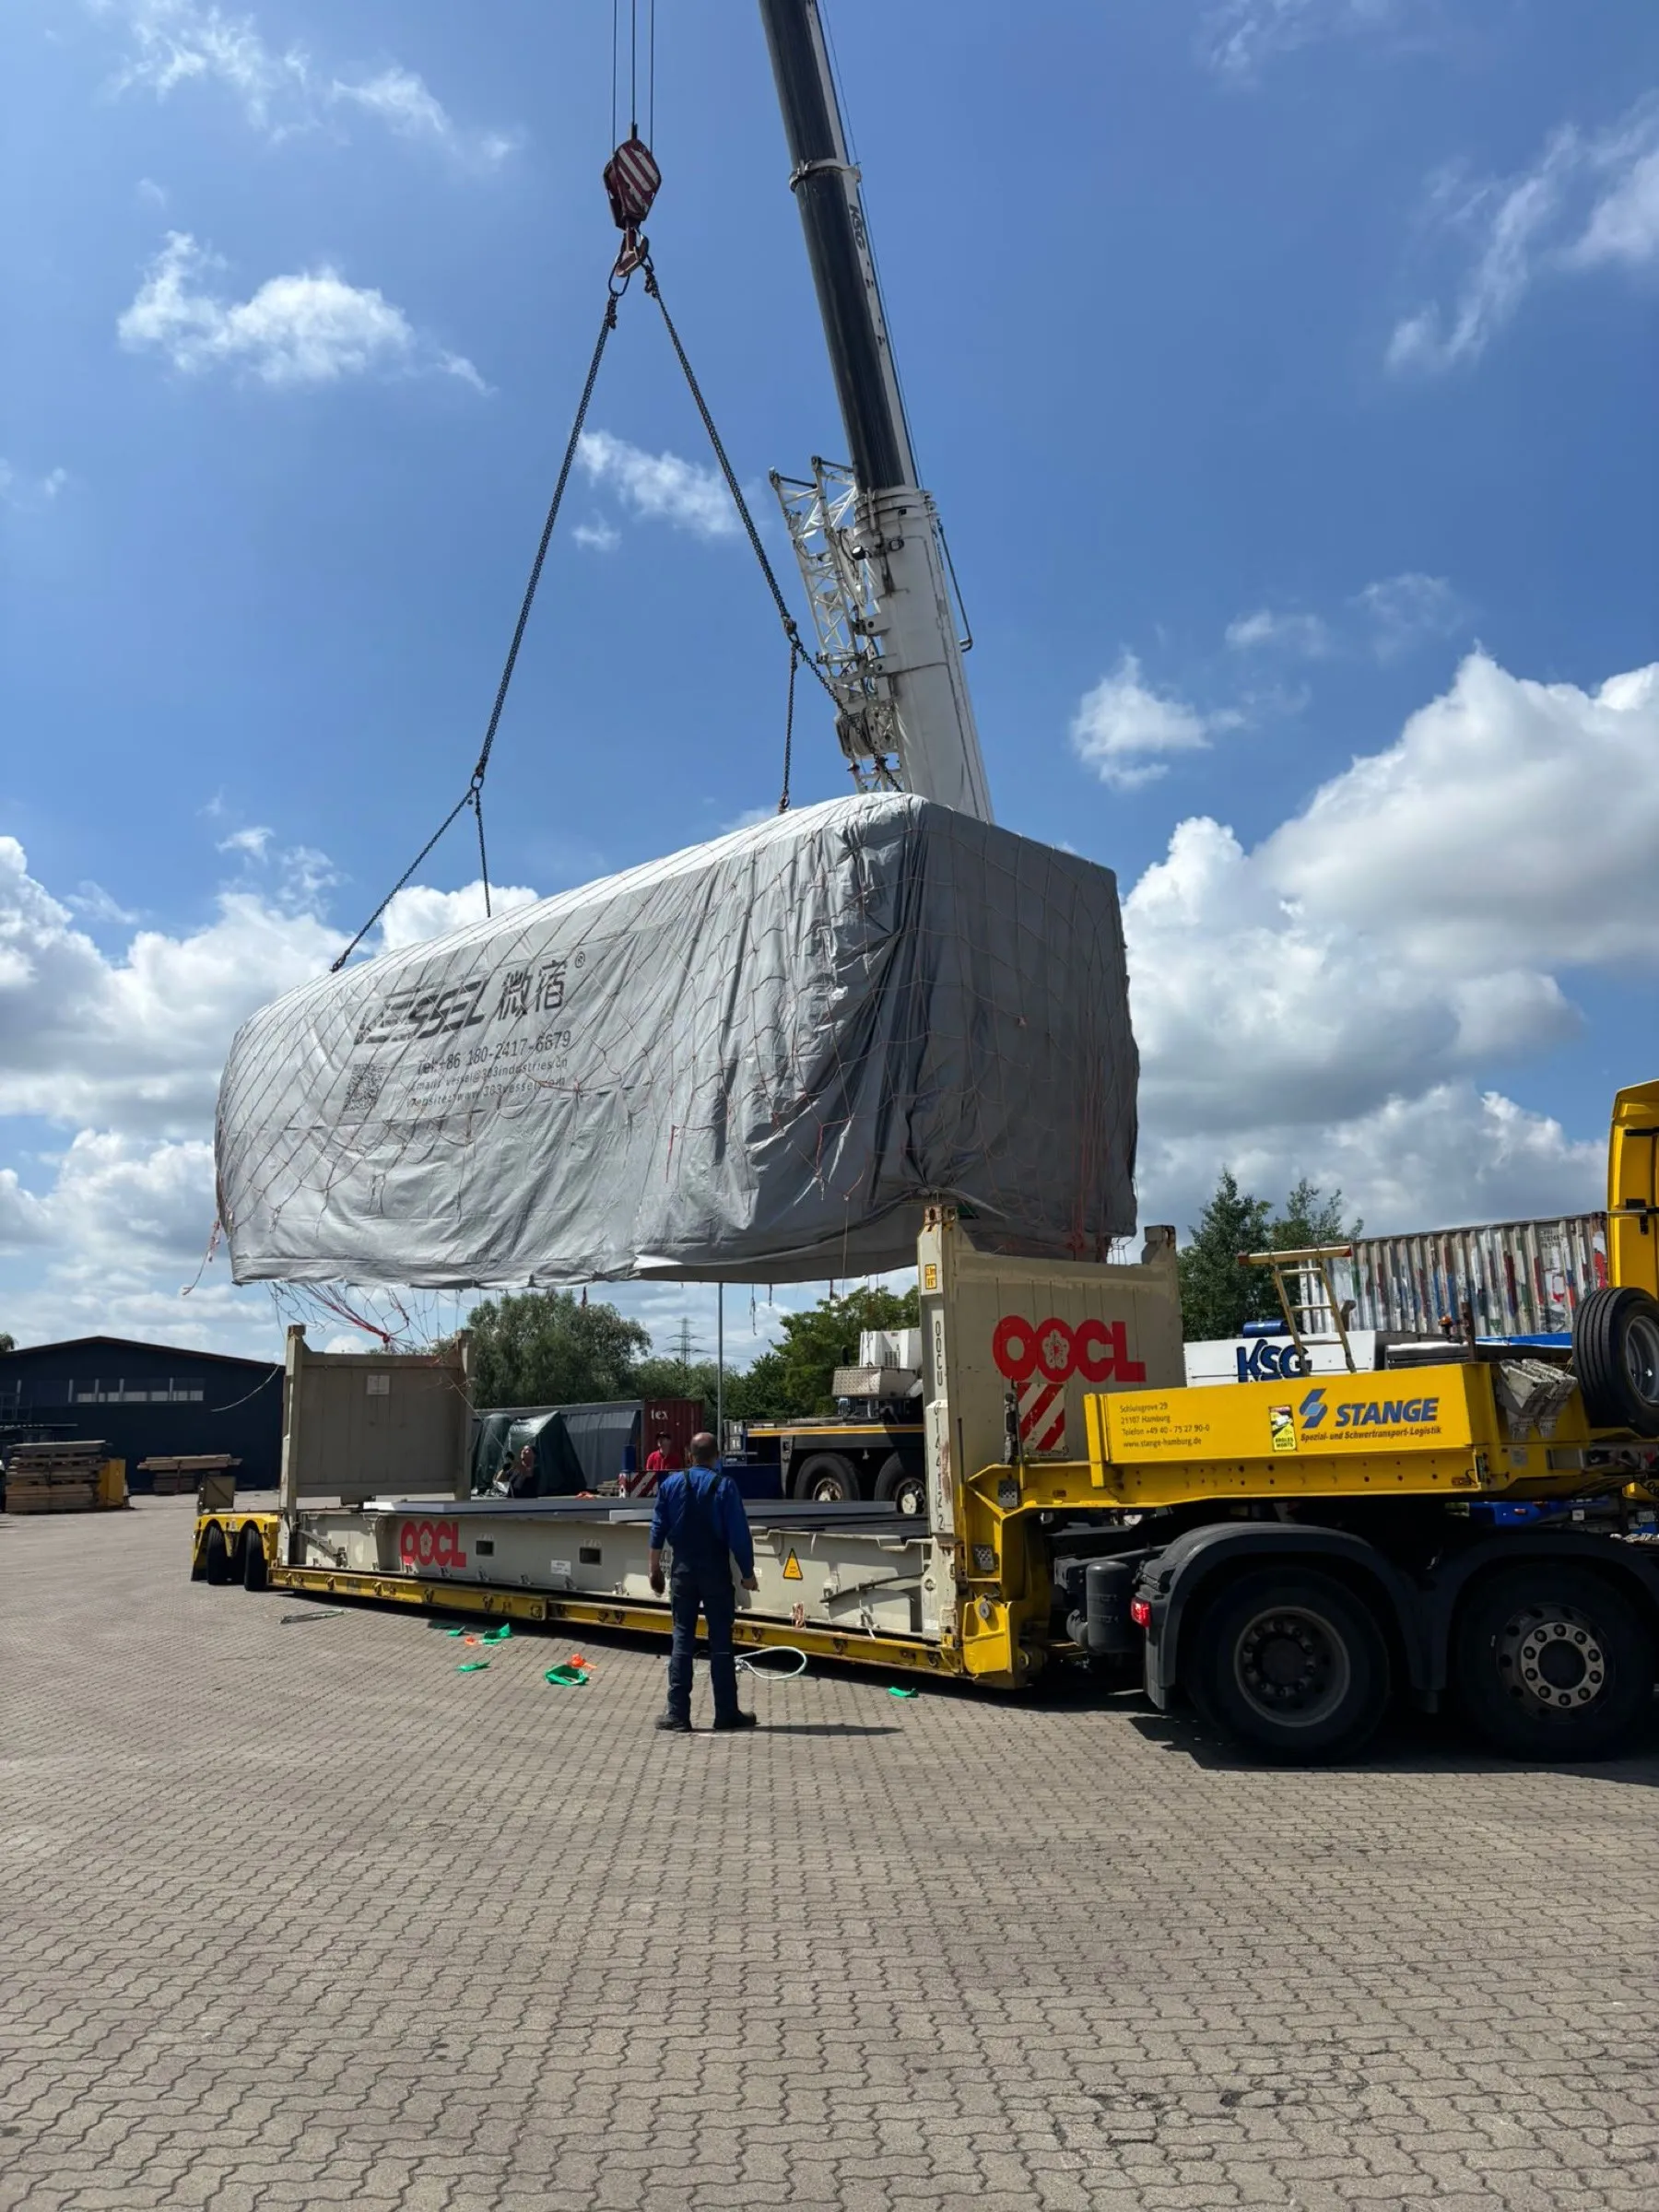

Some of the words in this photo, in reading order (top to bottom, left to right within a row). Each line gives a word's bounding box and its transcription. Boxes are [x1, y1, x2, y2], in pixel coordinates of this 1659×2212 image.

[993, 1315, 1147, 1382] OOCL
[1236, 1338, 1312, 1382] KSG
[651, 1408, 668, 1420] tex
[1142, 1416, 1171, 1424] Hamburg
[1335, 1397, 1440, 1428] STANGE
[1122, 1428, 1144, 1436] Telefon
[1300, 1431, 1328, 1443] Spezial-
[1330, 1430, 1343, 1440] und
[1345, 1426, 1442, 1440] Schwertransport-Logistik
[1124, 1437, 1202, 1449] www.stange-hamburg.de
[400, 1520, 467, 1570] OOCL
